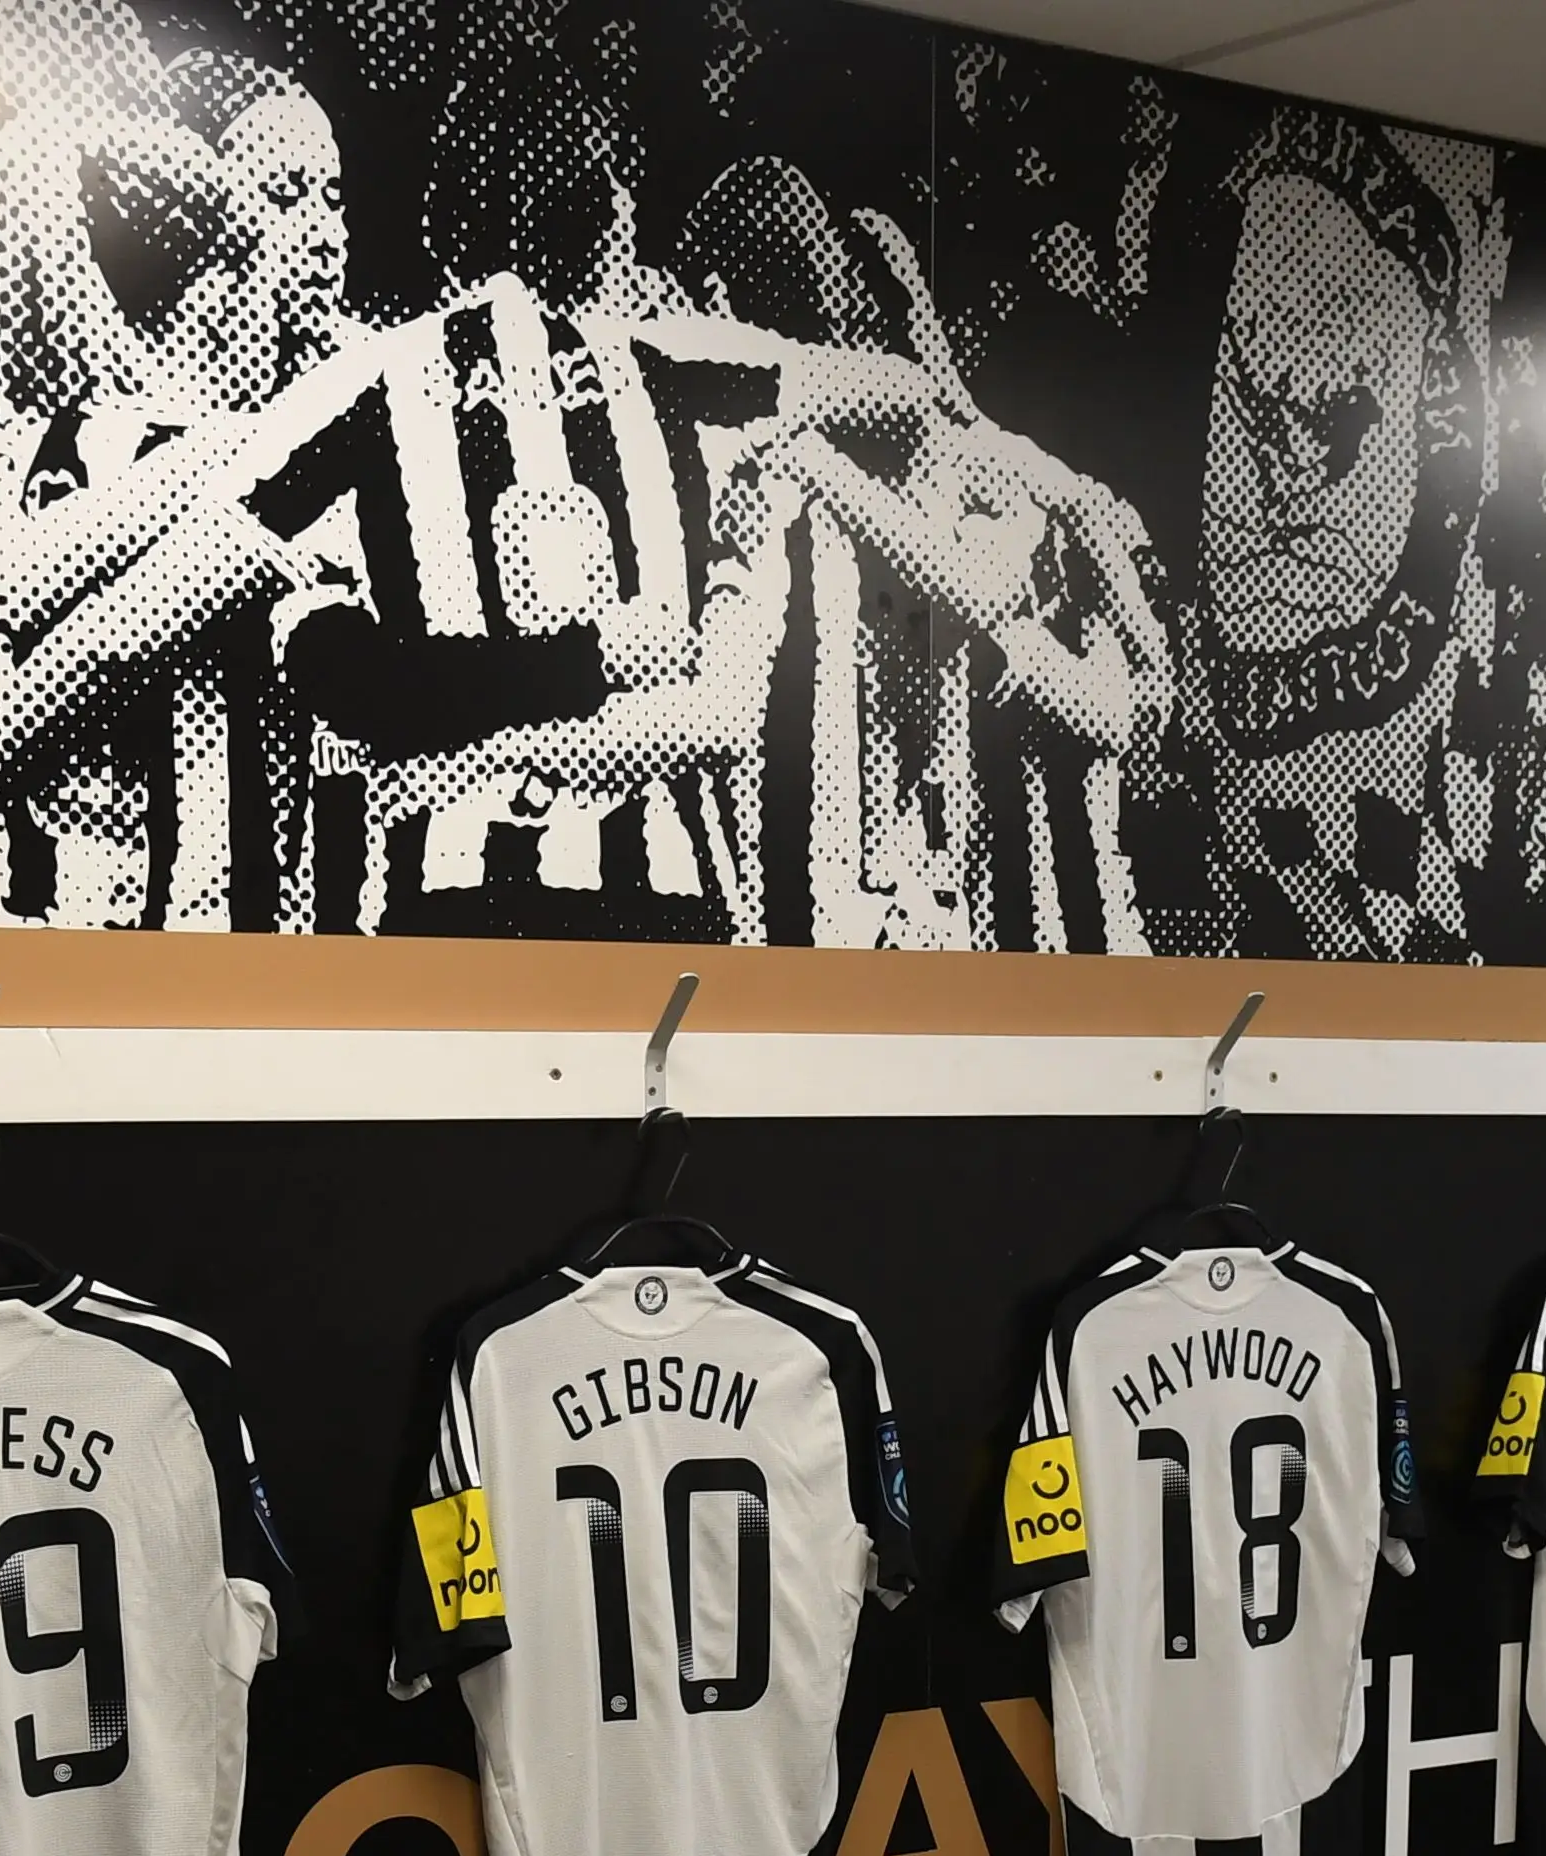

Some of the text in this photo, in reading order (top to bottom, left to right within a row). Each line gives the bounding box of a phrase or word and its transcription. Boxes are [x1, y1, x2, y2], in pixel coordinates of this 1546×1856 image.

[552, 1356, 759, 1441] GIBSON
[1112, 1327, 1321, 1427] HAYWOOD
[1014, 1508, 1082, 1543] noo
[1137, 1414, 1308, 1659] 18
[555, 1457, 770, 1722] 10
